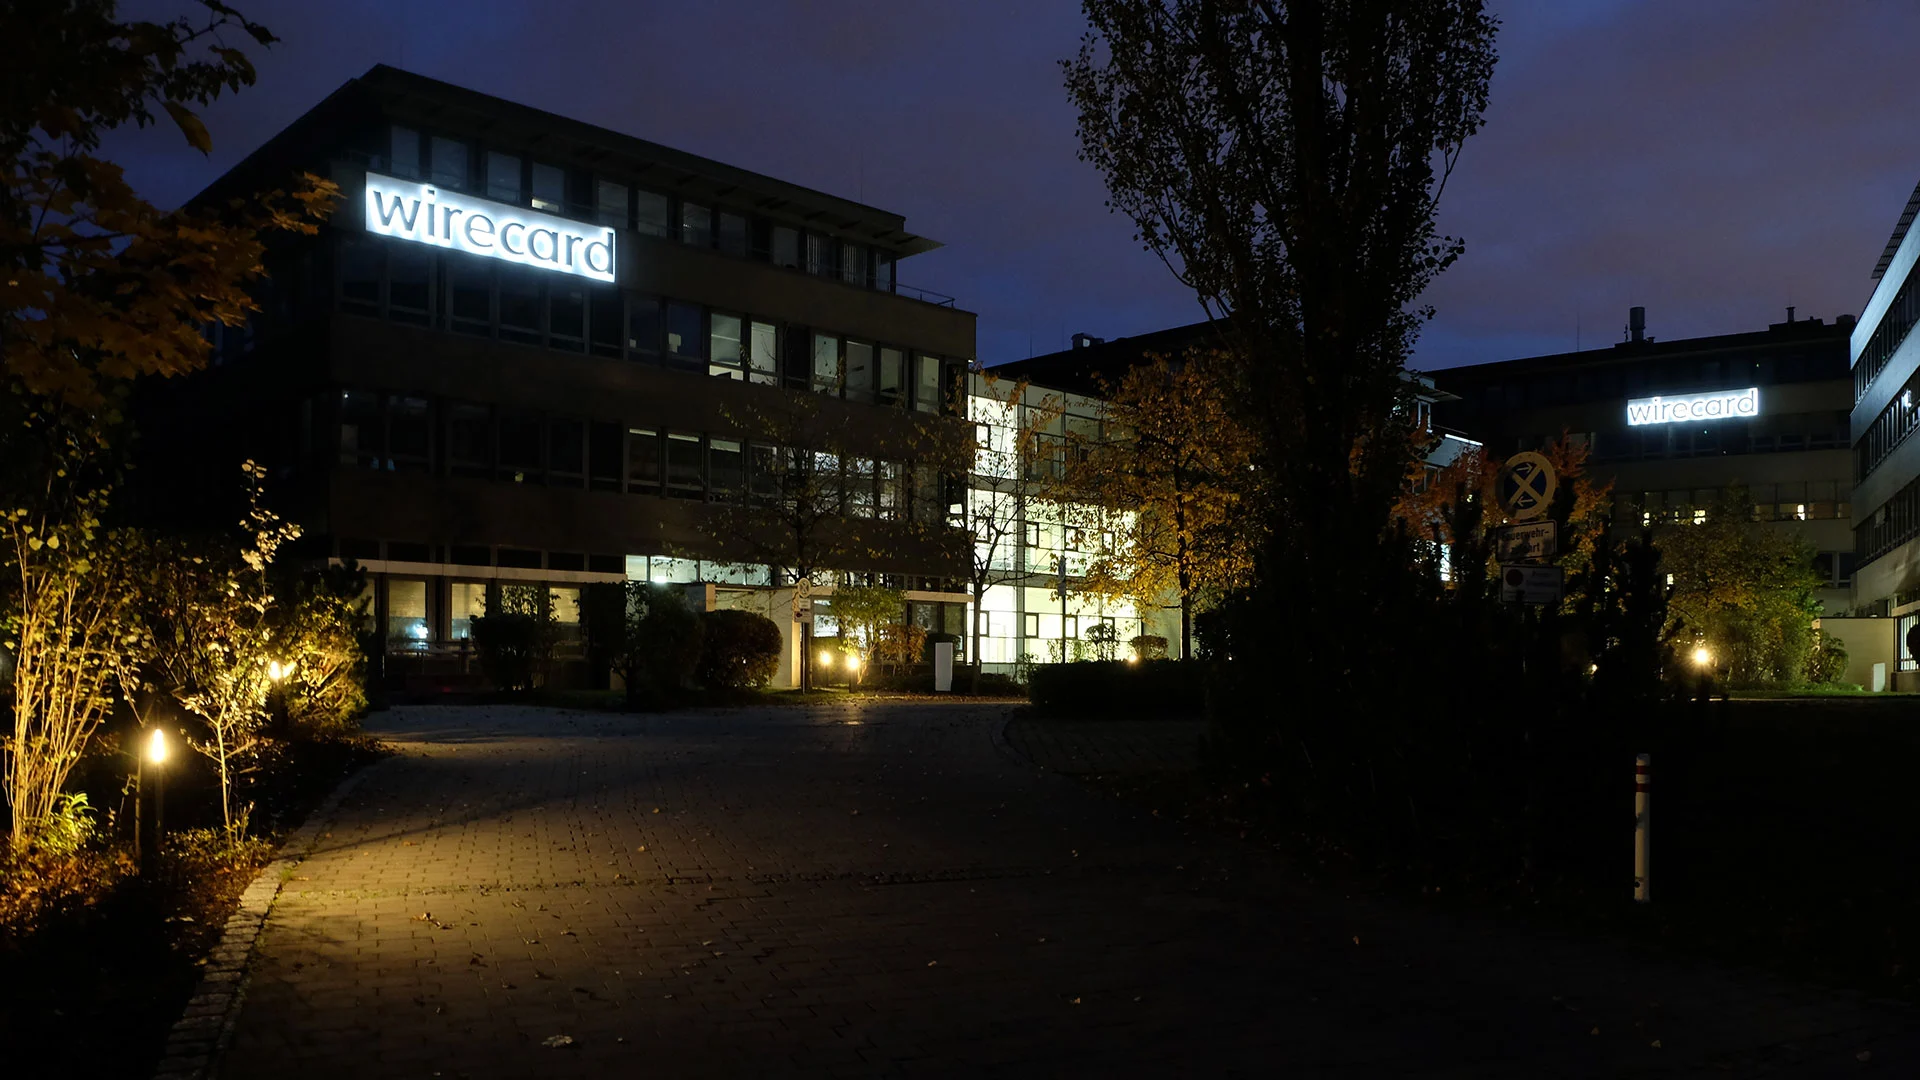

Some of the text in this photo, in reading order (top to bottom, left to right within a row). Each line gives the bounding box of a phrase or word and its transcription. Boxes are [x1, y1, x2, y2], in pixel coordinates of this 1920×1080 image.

[373, 188, 614, 275] wirecard
[1629, 390, 1754, 422] wirecard
[1502, 527, 1549, 541] uerwehr-
